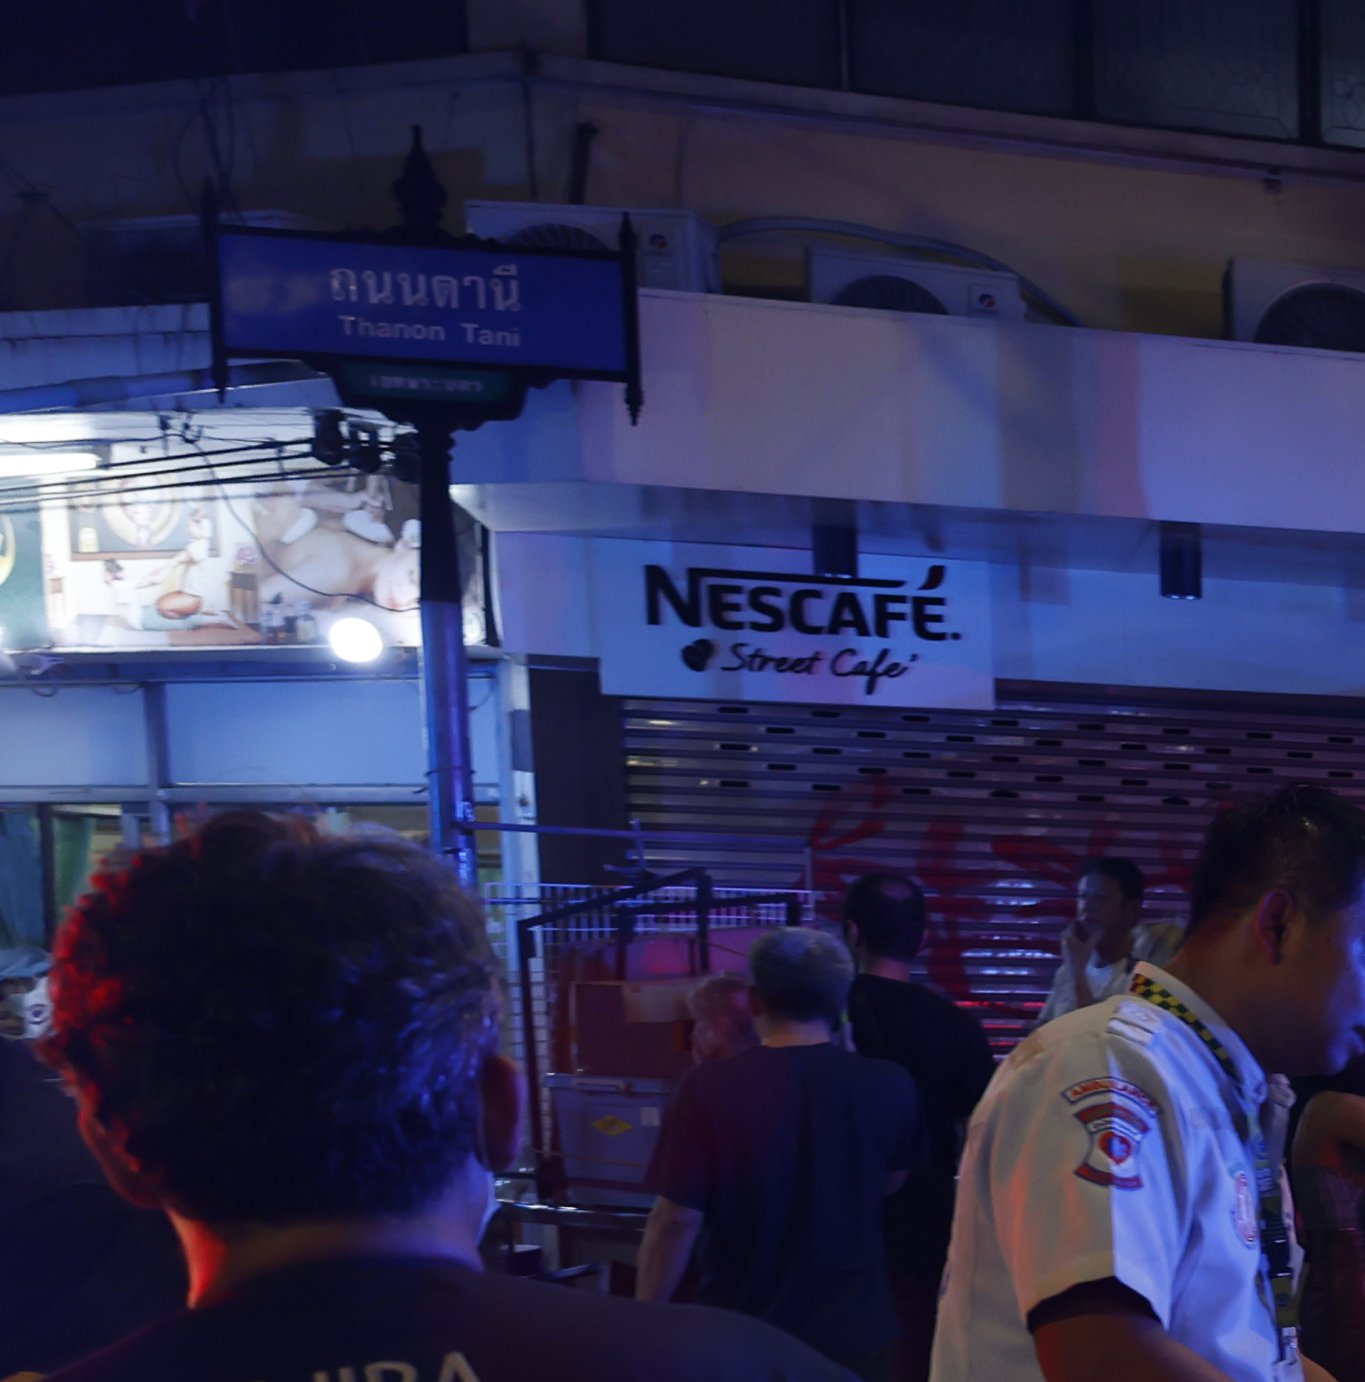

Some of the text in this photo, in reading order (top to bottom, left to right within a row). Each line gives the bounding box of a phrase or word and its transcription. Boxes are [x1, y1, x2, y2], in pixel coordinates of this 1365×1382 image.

[329, 263, 522, 312] ถนนตานี
[338, 314, 521, 348] Thanon Tani
[720, 642, 821, 677] Street
